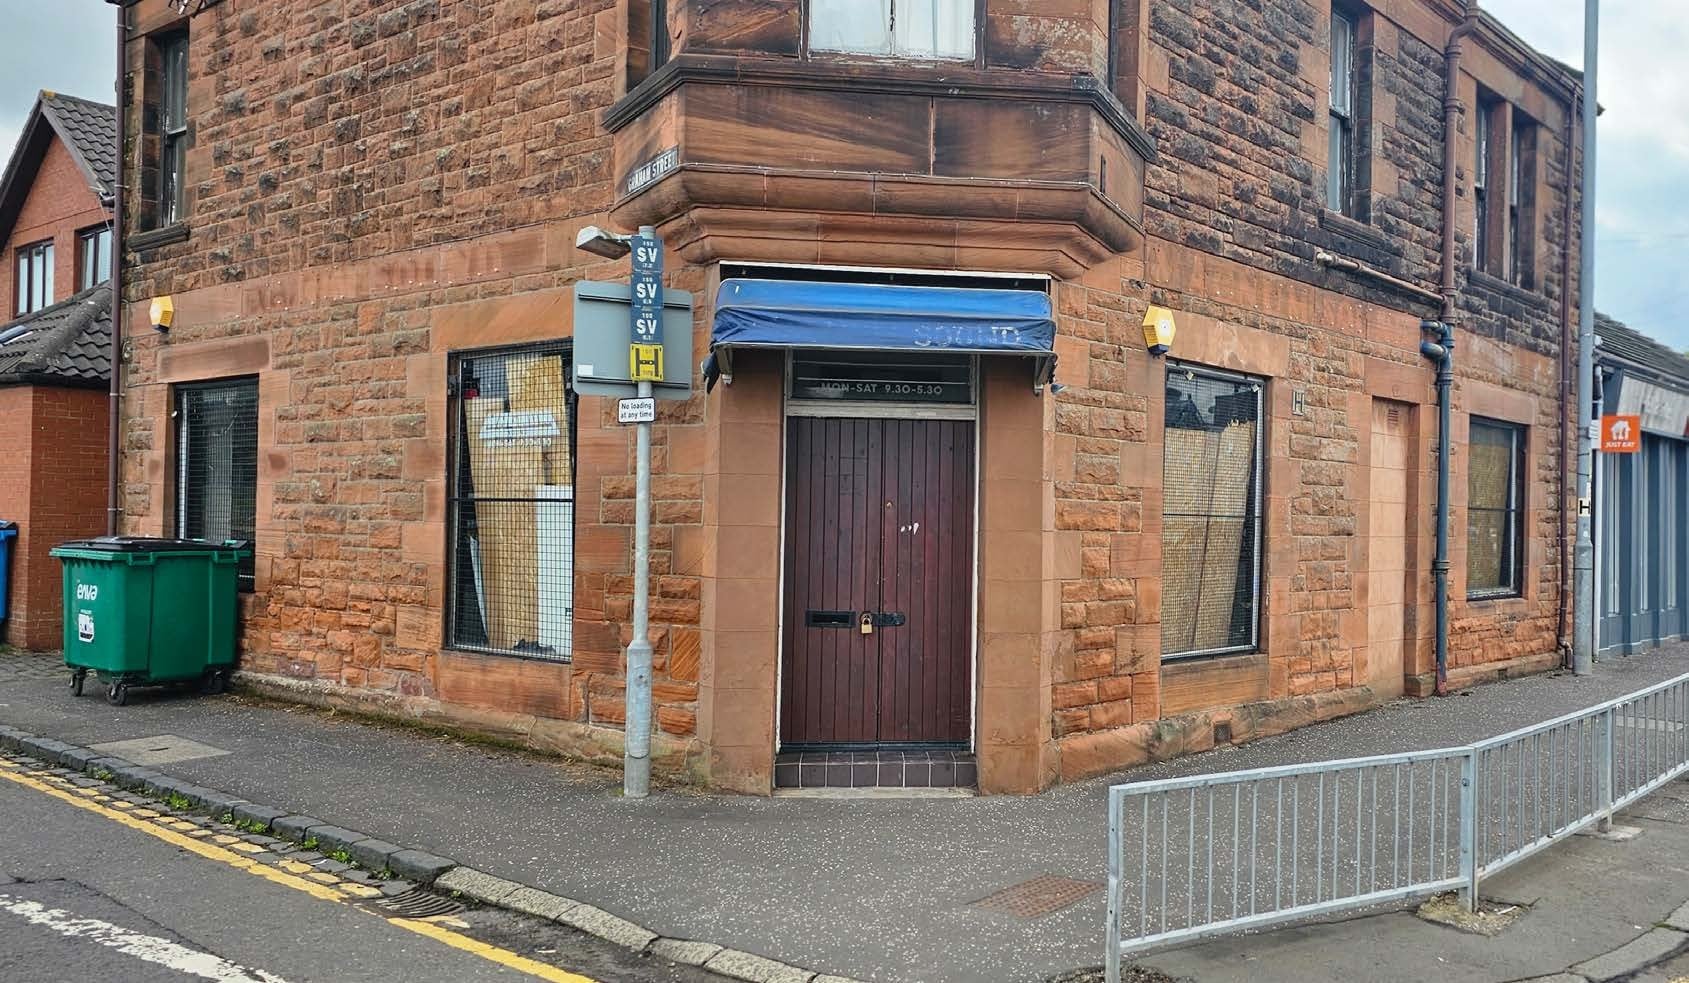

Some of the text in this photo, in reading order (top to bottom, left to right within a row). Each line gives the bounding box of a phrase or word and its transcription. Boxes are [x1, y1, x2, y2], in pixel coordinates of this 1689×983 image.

[637, 247, 658, 263] SV
[636, 283, 657, 299] SV
[636, 319, 657, 335] SV
[635, 348, 659, 377] H
[819, 383, 943, 396] MON-SAT 9.30-5.30
[630, 402, 652, 410] loading
[628, 412, 638, 420] any
[77, 583, 98, 601] enva
